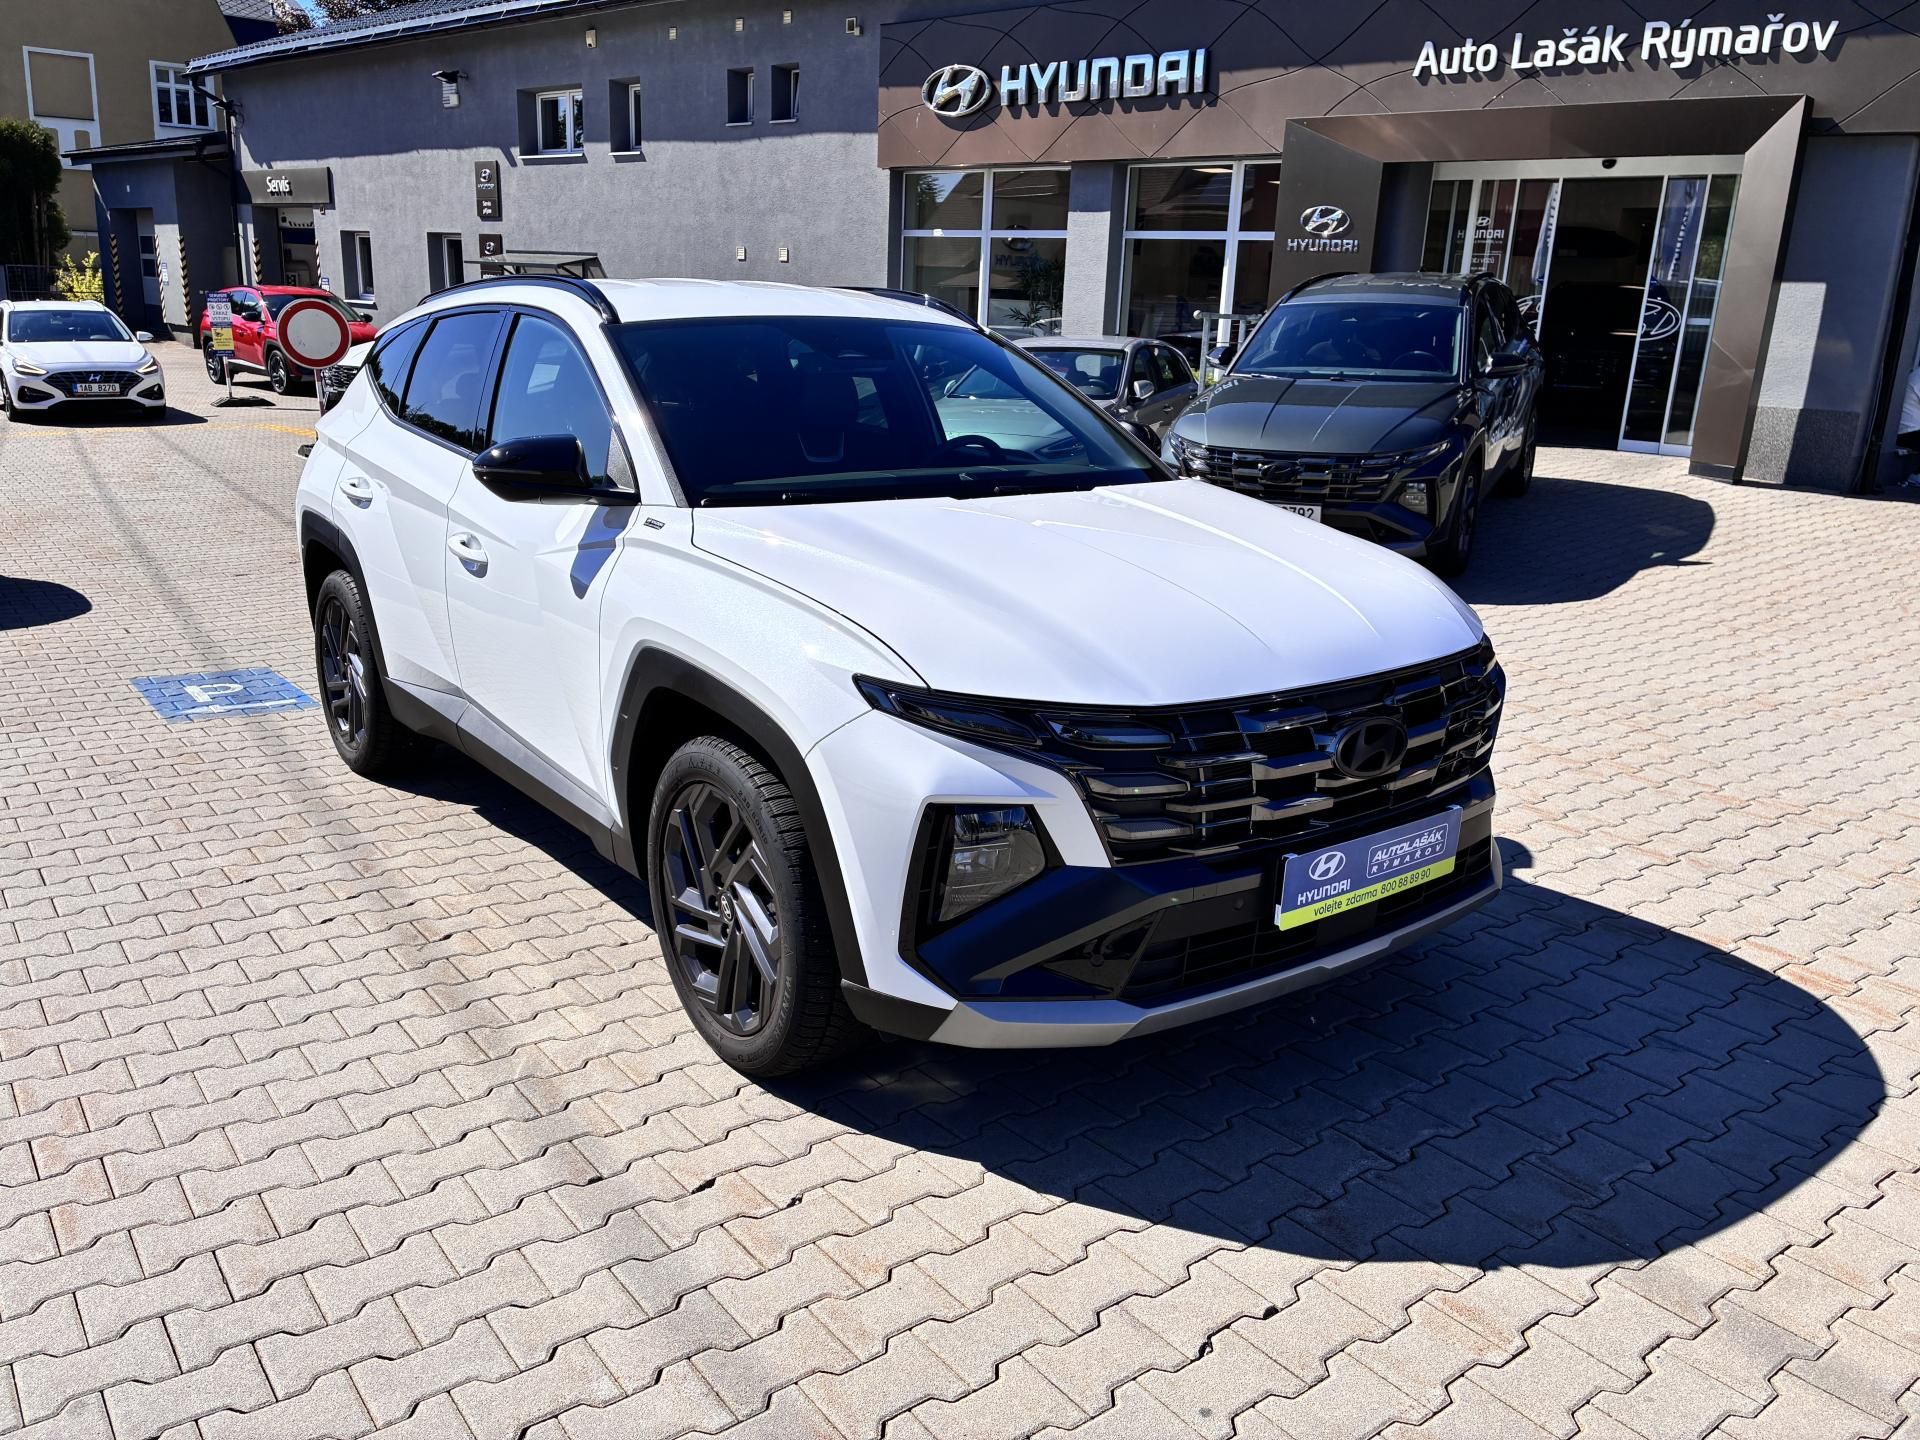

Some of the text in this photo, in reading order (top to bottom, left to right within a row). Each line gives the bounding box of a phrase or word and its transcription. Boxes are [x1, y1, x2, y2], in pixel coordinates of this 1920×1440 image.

[1412, 13, 1839, 77] Auto Lašák Rýmařov
[1000, 48, 1206, 106] HYUNDAI
[266, 175, 290, 192] Servis
[1287, 238, 1358, 252] HYUNDAI
[1457, 229, 1505, 239] HUNDAI
[1370, 844, 1442, 874] RÝMAŘOV
[1372, 829, 1444, 862] AUTOLAŠÁK
[1297, 879, 1351, 906] HYUNDAI
[1313, 868, 1431, 917] volejte zdarma 800 88 89 90
